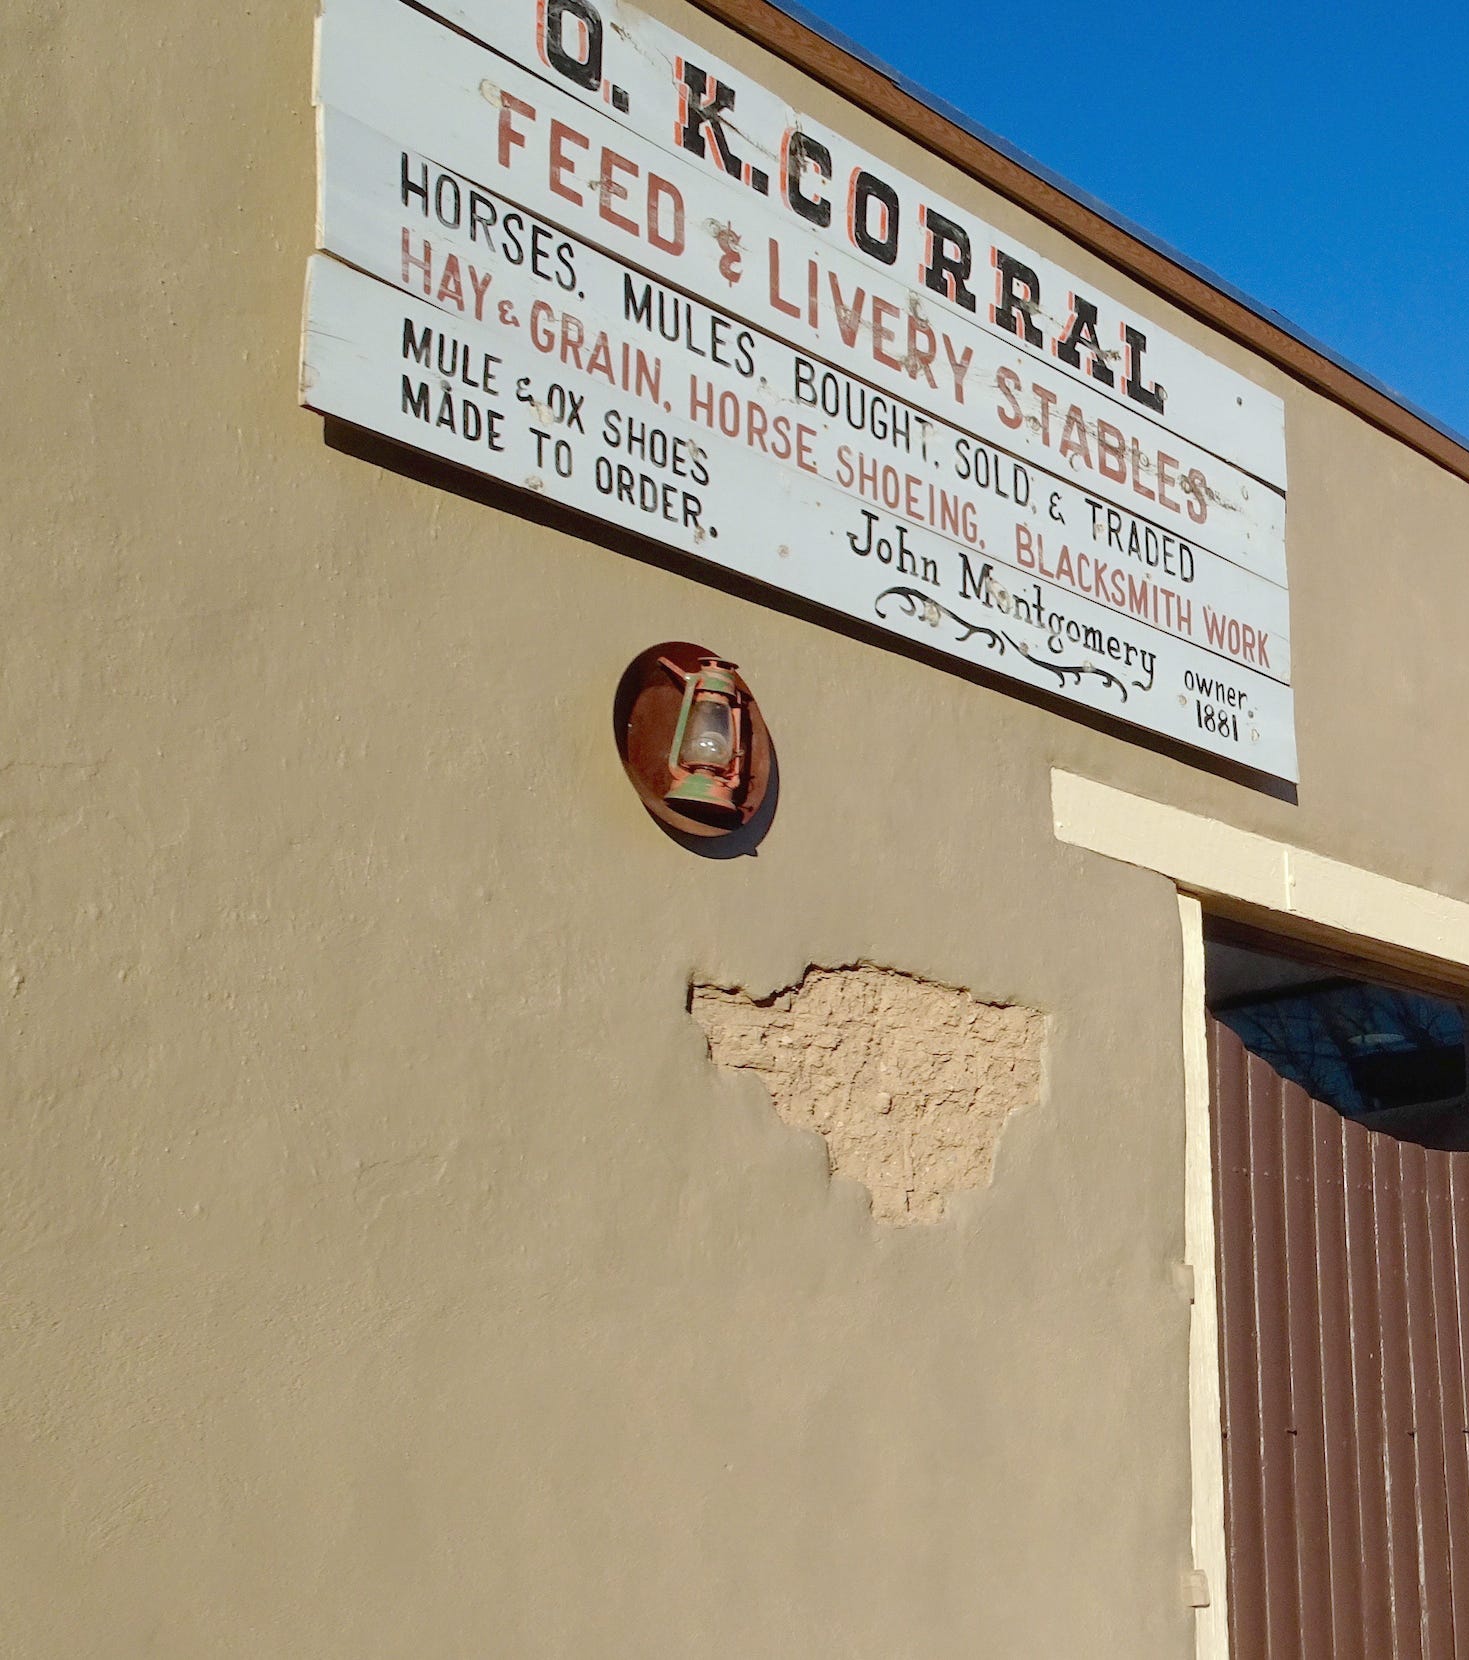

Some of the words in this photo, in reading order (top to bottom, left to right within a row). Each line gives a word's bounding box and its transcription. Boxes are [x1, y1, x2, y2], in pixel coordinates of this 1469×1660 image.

[536, 0, 630, 114] O.
[497, 90, 686, 257] FEED
[717, 219, 744, 288] &
[768, 238, 975, 405] LIVERY
[996, 366, 1209, 525] STABLES
[401, 226, 493, 323] HAY
[497, 299, 521, 328] &
[530, 299, 671, 413] GRAIN,
[1015, 522, 1192, 636] BLACKSMITH
[1202, 606, 1271, 669] WORK
[401, 375, 505, 452] MADE
[530, 427, 573, 478] TO
[595, 456, 718, 538] ORDER.
[402, 318, 502, 397] MULE
[515, 377, 537, 407] &
[547, 383, 585, 434] OX
[602, 409, 710, 486] SHOES
[846, 509, 942, 587] John
[959, 553, 1156, 691] Montgomery
[1049, 491, 1066, 525] &
[1084, 497, 1195, 583] TRADED
[1195, 699, 1239, 742] 1881
